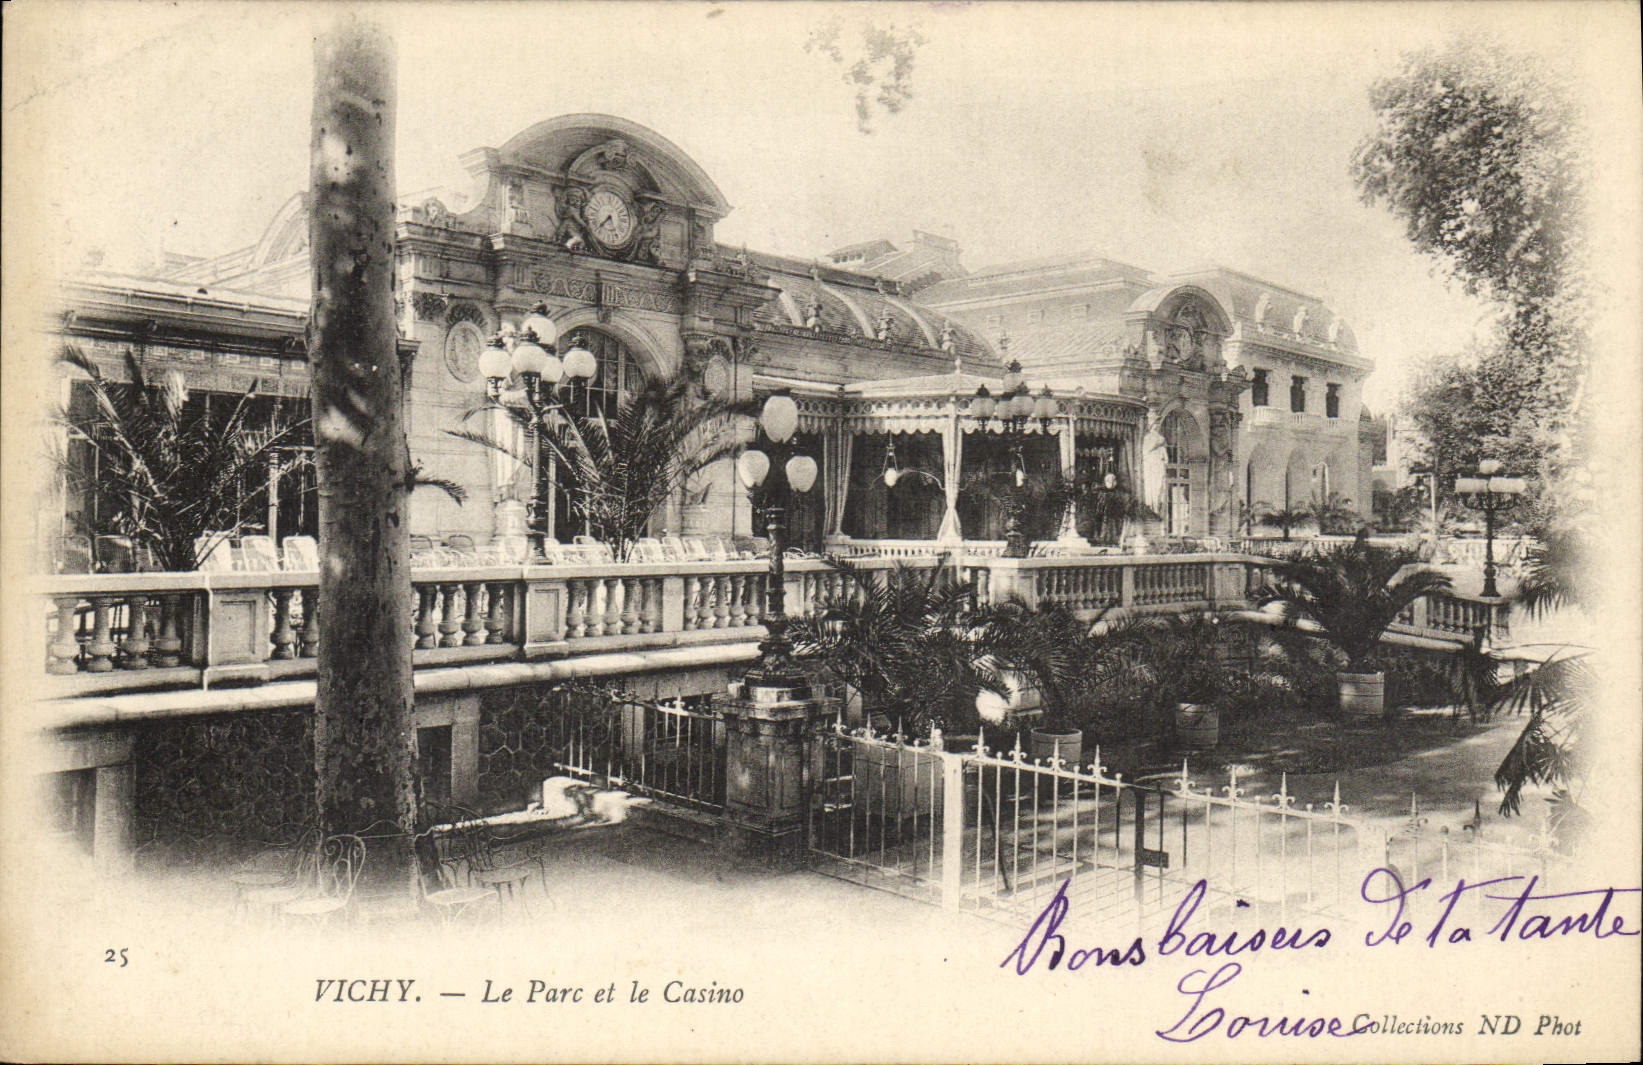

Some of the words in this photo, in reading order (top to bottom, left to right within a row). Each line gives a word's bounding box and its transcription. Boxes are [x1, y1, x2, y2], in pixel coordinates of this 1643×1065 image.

[1000, 877, 1147, 976] Bons
[1486, 875, 1643, 943] tante
[1156, 961, 1376, 1043] Louise
